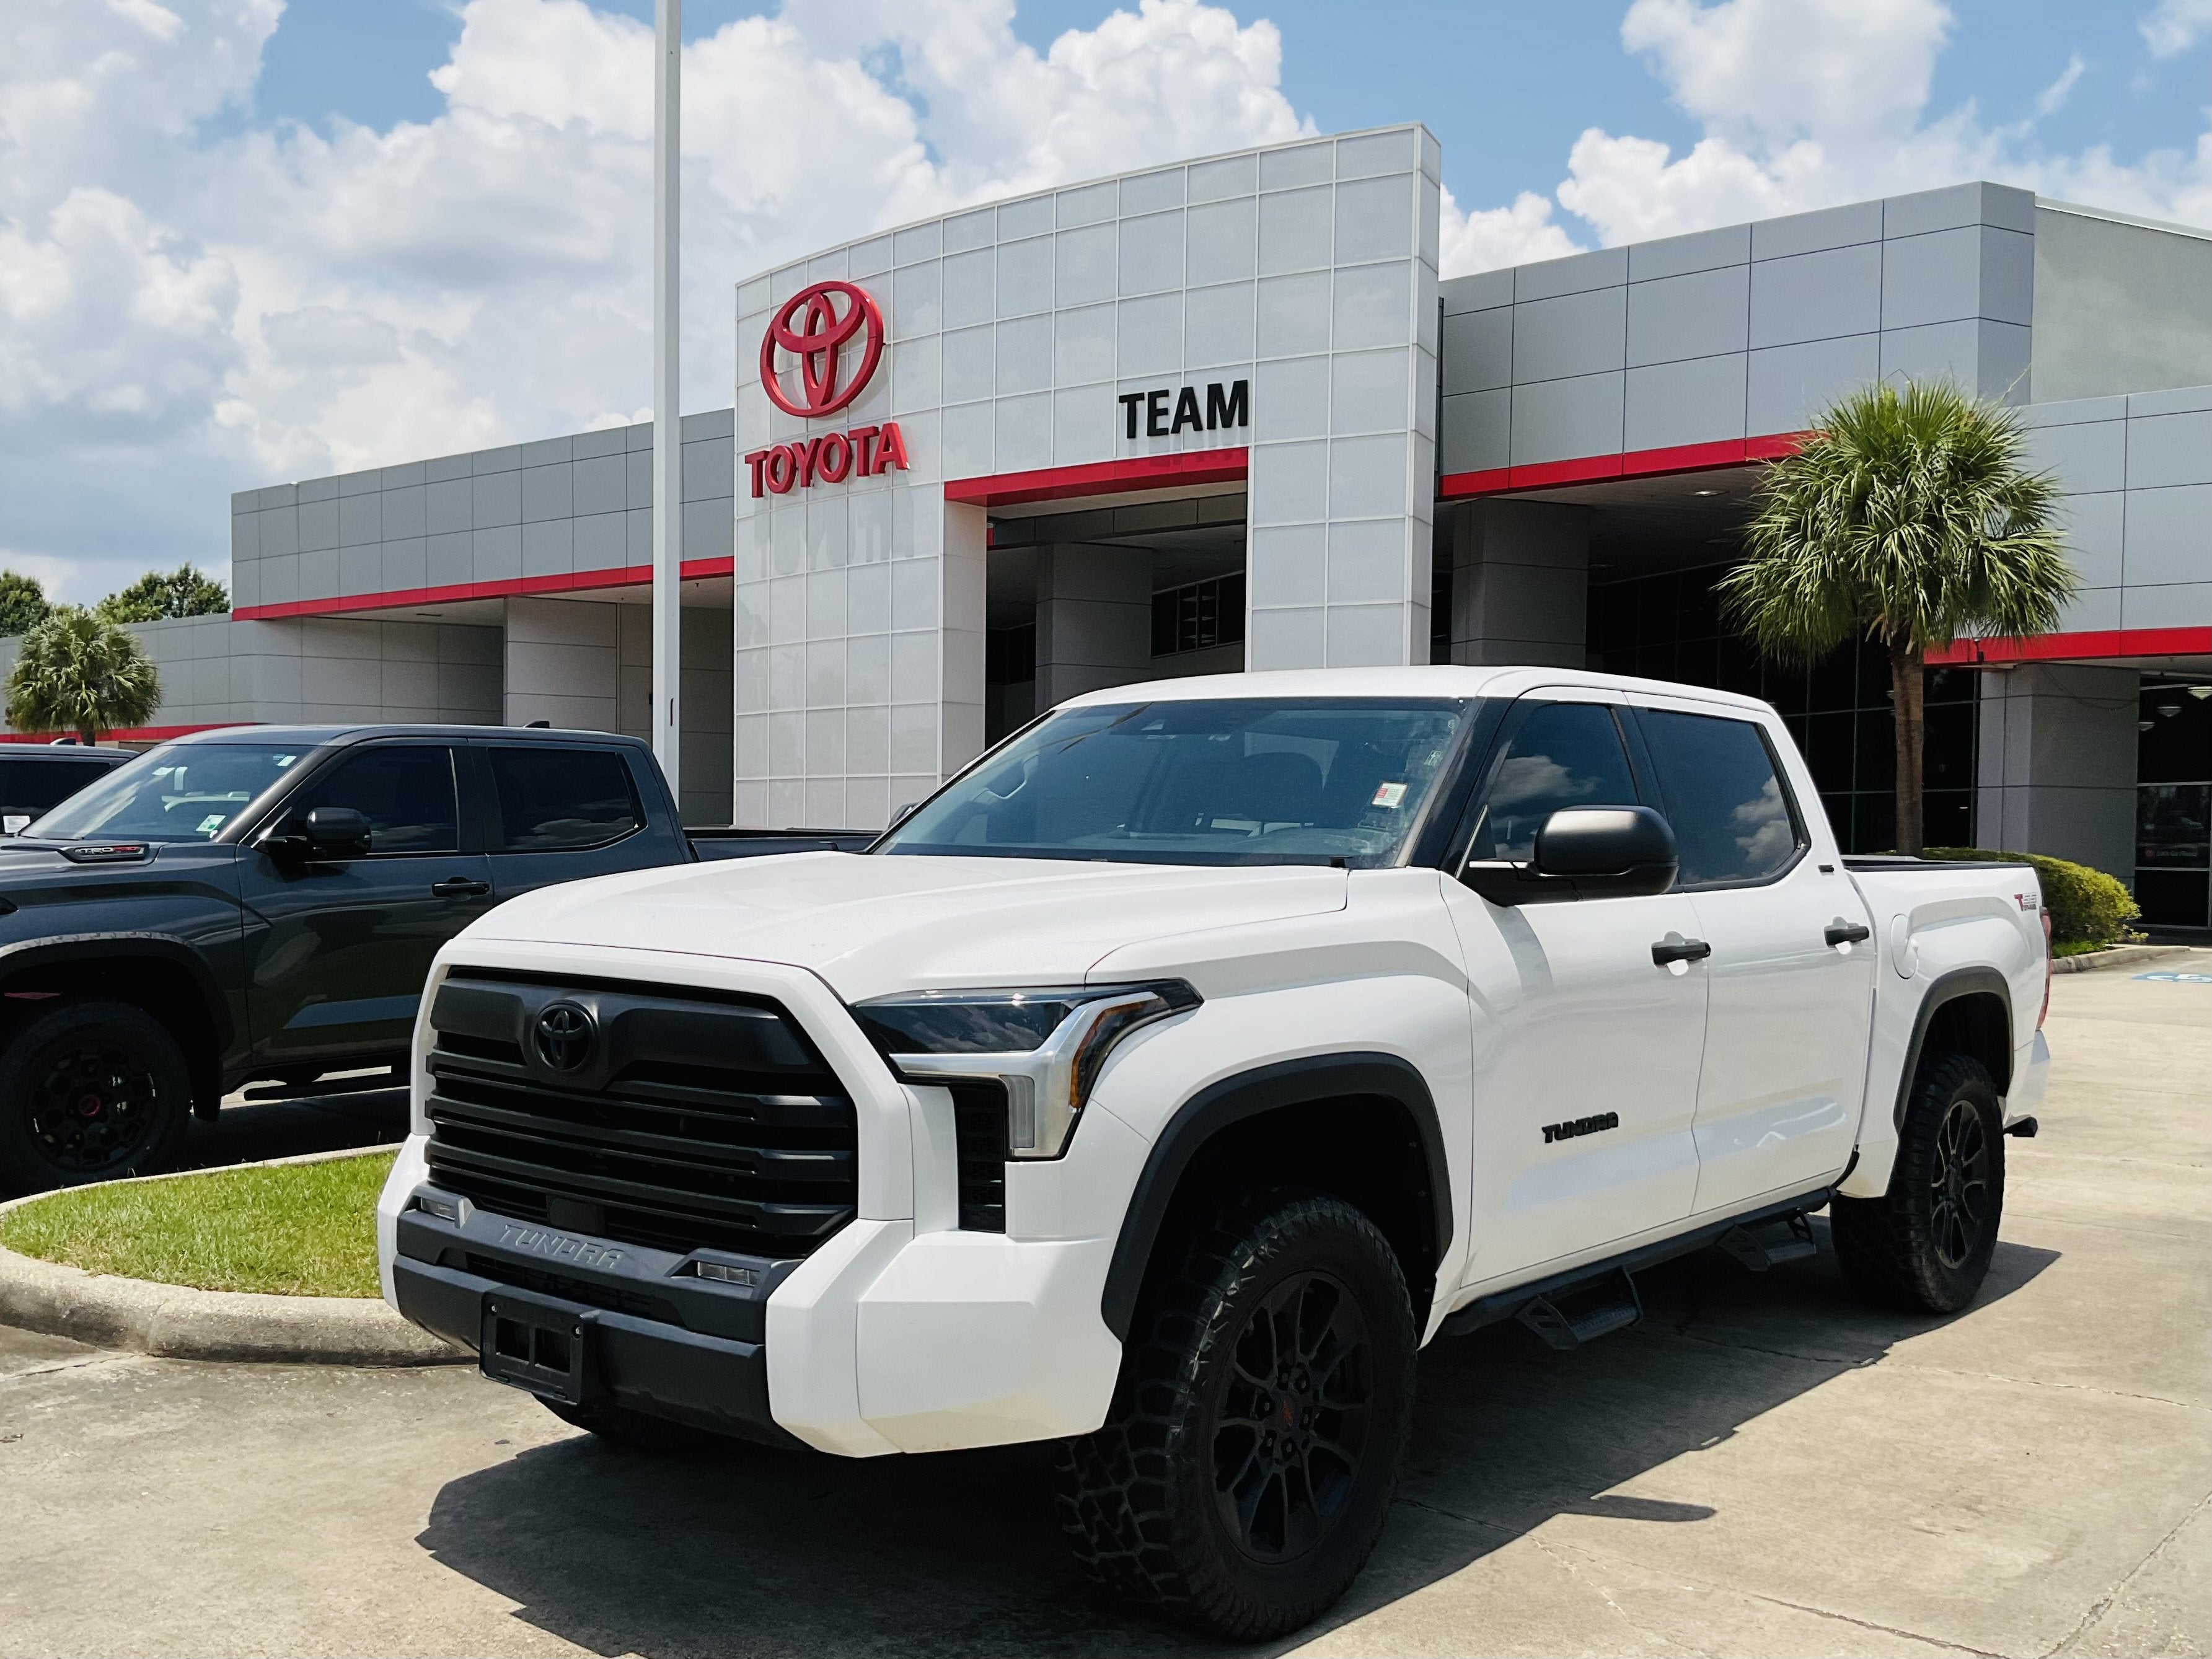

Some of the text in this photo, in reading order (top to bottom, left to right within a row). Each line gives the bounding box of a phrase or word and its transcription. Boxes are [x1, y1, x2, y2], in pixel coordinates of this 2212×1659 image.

[1118, 379, 1248, 439] TEAM
[744, 423, 910, 498] TOYOTA
[74, 847, 113, 855] TRD
[1541, 1111, 1618, 1143] TUNDRA
[499, 1223, 625, 1269] TUNDRA
